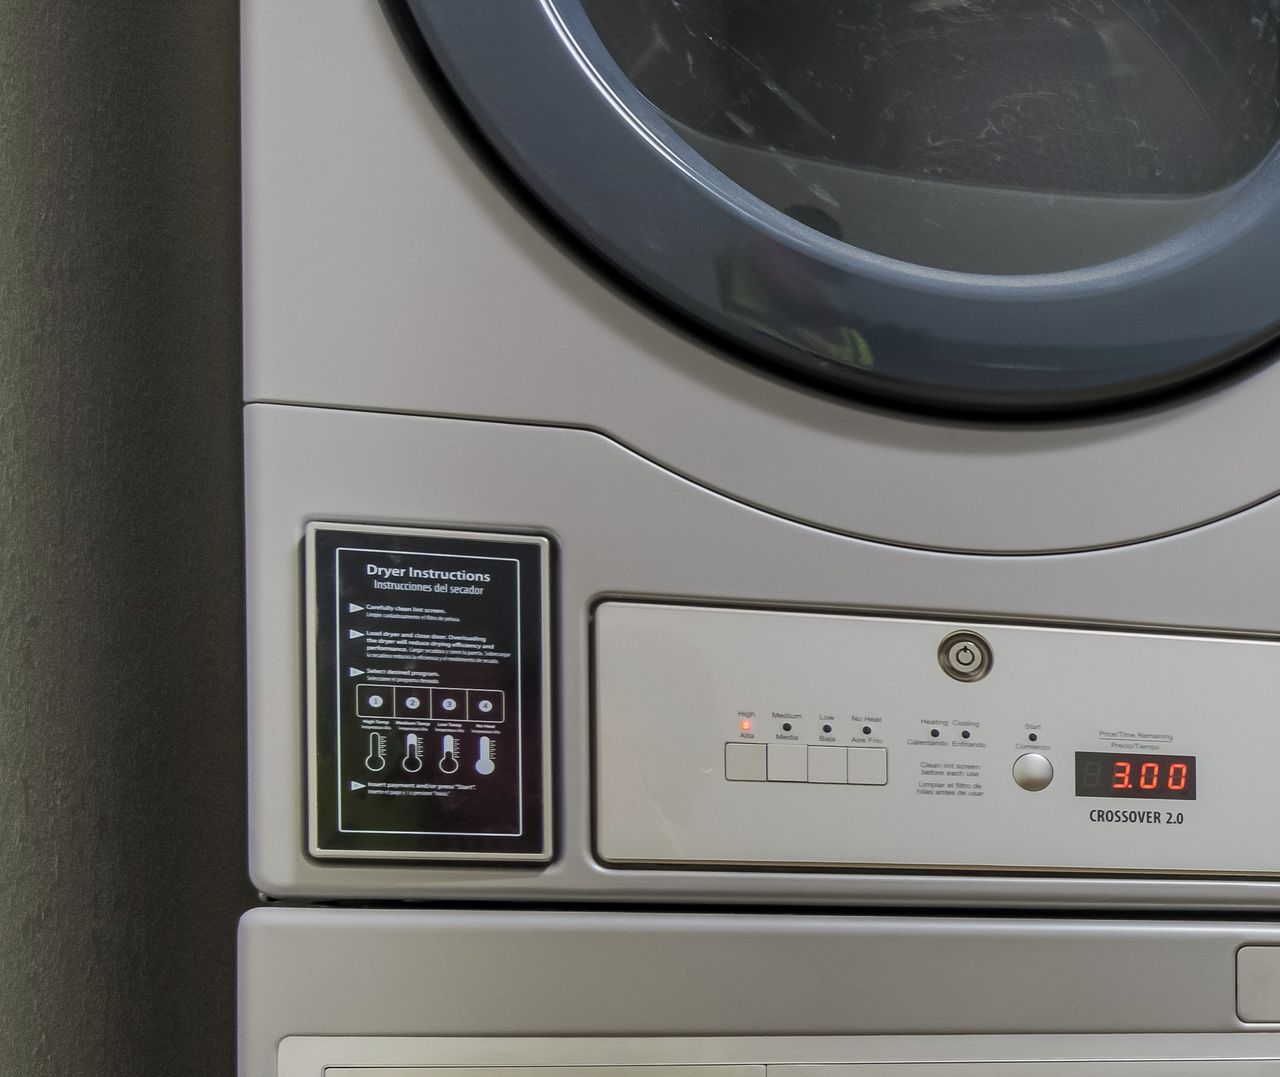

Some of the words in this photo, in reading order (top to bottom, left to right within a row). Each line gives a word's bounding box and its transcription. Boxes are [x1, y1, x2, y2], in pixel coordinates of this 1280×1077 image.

[366, 564, 406, 578] Dryer
[409, 566, 491, 582] Instructions
[374, 579, 432, 592] Instrucciones
[434, 583, 448, 593] del
[450, 585, 484, 596] secador
[366, 603, 395, 612] Carefully
[920, 719, 948, 727] Heating
[952, 720, 980, 728] Cooling
[776, 733, 799, 741] Media
[1098, 730, 1135, 739] Price/Time
[1137, 731, 1174, 741] Remaining
[907, 739, 949, 747] Calentando
[1015, 743, 1051, 751] Comienzo
[1111, 742, 1160, 751] Precio/Tiempo
[920, 761, 942, 769] Clean
[1112, 761, 1188, 790] 3.00
[918, 781, 945, 789] Limpiar
[1089, 809, 1161, 824] CROSSOVER
[1165, 812, 1184, 825] 2.0
